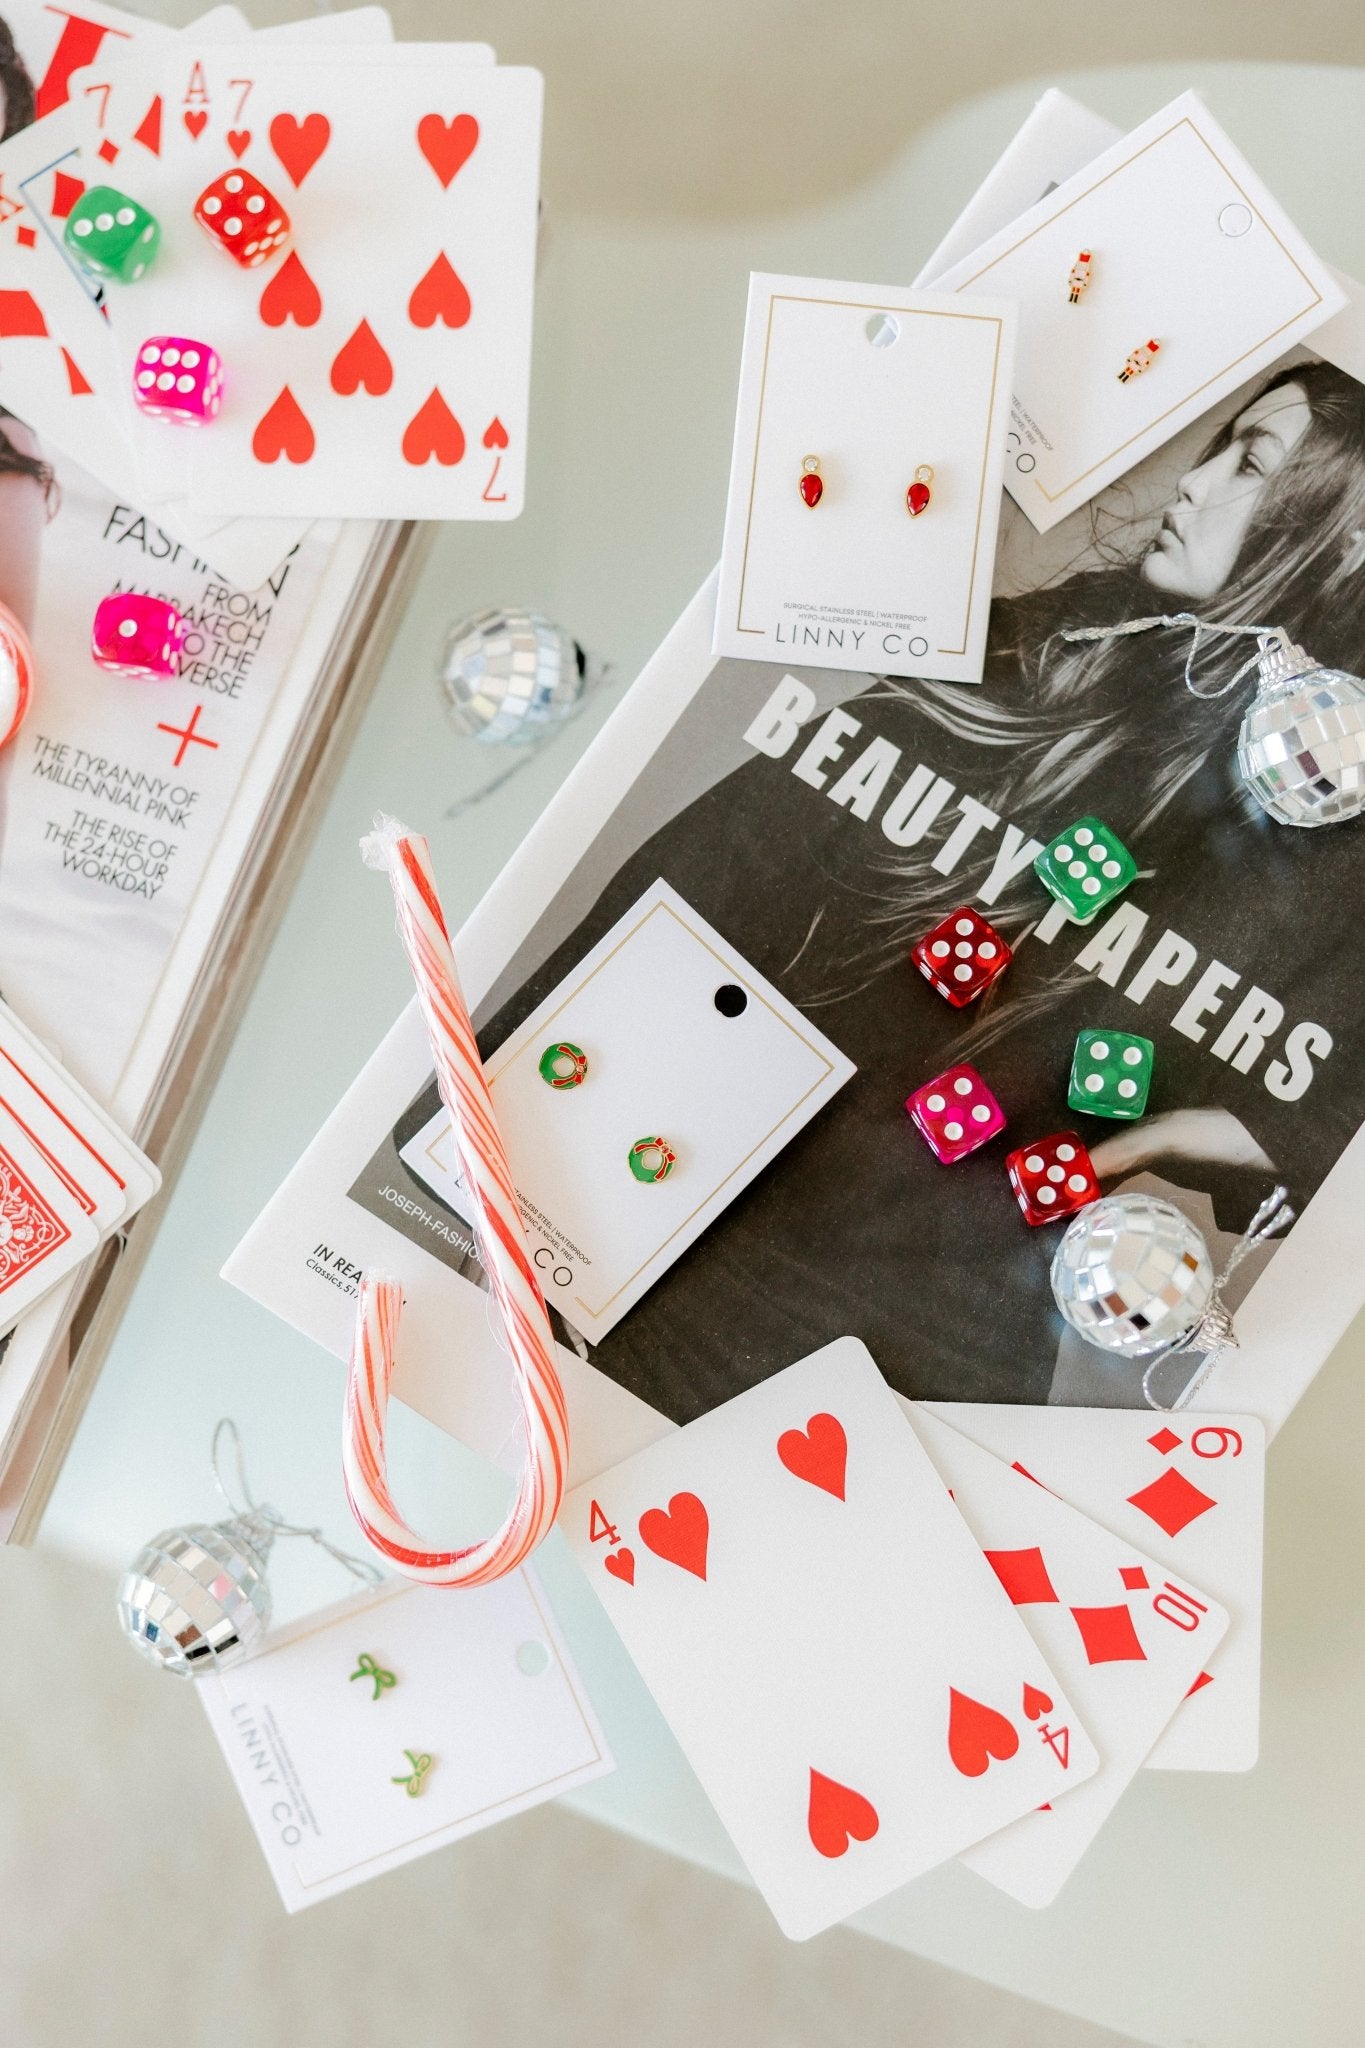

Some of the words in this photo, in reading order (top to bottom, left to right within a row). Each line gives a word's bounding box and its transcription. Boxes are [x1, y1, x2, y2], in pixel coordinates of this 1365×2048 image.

[183, 61, 209, 103] A
[228, 80, 254, 123] 7
[85, 83, 112, 129] 7
[483, 456, 506, 501] 7
[201, 583, 272, 626] FROM
[783, 602, 817, 612] SURGICAL
[820, 606, 855, 616] STAINLESS
[856, 609, 875, 618] STEEL
[881, 612, 928, 623] WATERPROOF
[798, 613, 862, 626] HYPO-ALLERGENIC
[869, 620, 893, 629] NICKEL
[895, 623, 911, 631] FREE
[211, 640, 256, 675] THE
[776, 623, 865, 650] LINNY
[883, 634, 928, 657] CO
[33, 735, 71, 763] THE
[74, 749, 170, 798] TYRANNY
[169, 786, 199, 808] OF
[743, 674, 1046, 906] BEAUTY
[32, 761, 141, 813] MILLENNIAL
[145, 799, 192, 829] PINK
[45, 821, 79, 849] THE
[81, 837, 169, 882] 24-HOUR
[71, 810, 108, 838] THE
[109, 824, 149, 853] RISE
[149, 840, 178, 861] OF
[63, 851, 162, 900] WORKDAY
[514, 1187, 539, 1215] TAINLESS
[537, 1212, 553, 1230] STEEL
[555, 1229, 592, 1266] WATERPROOF
[542, 1229, 561, 1250] NICKEL
[560, 1248, 574, 1262] FREE
[313, 1244, 334, 1262] IN
[534, 1248, 573, 1287] CO
[590, 1499, 621, 1545] 4
[1152, 1581, 1208, 1632] 10
[1037, 1723, 1068, 1769] 4
[271, 1801, 301, 1846] CO
